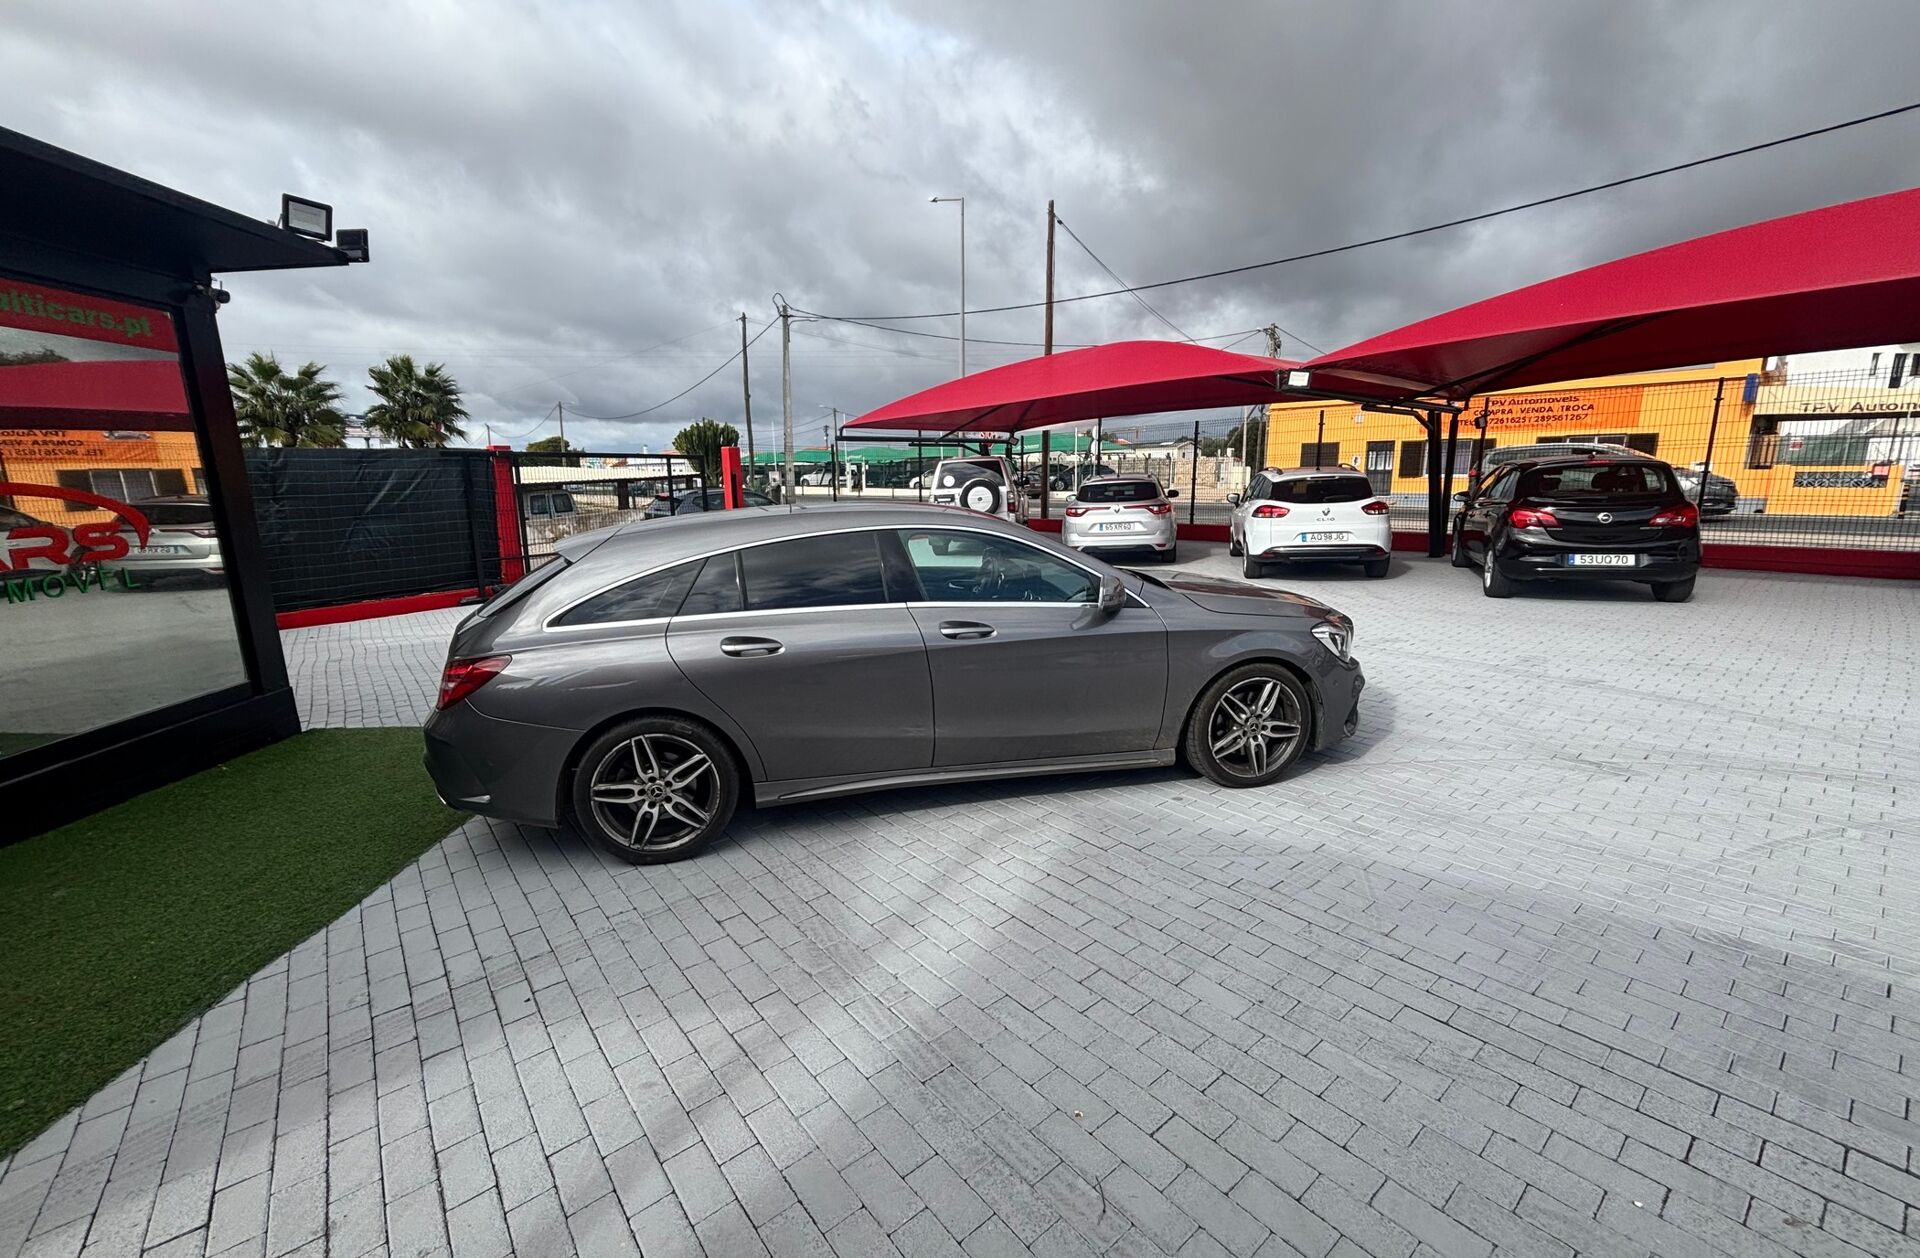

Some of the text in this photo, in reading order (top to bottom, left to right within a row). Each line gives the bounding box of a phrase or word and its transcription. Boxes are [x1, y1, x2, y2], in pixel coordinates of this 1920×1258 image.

[1519, 406, 1554, 414] VENDA
[1560, 404, 1595, 412] TROCA
[1800, 401, 1920, 412] TPV Autom
[1486, 417, 1527, 425] 7261625
